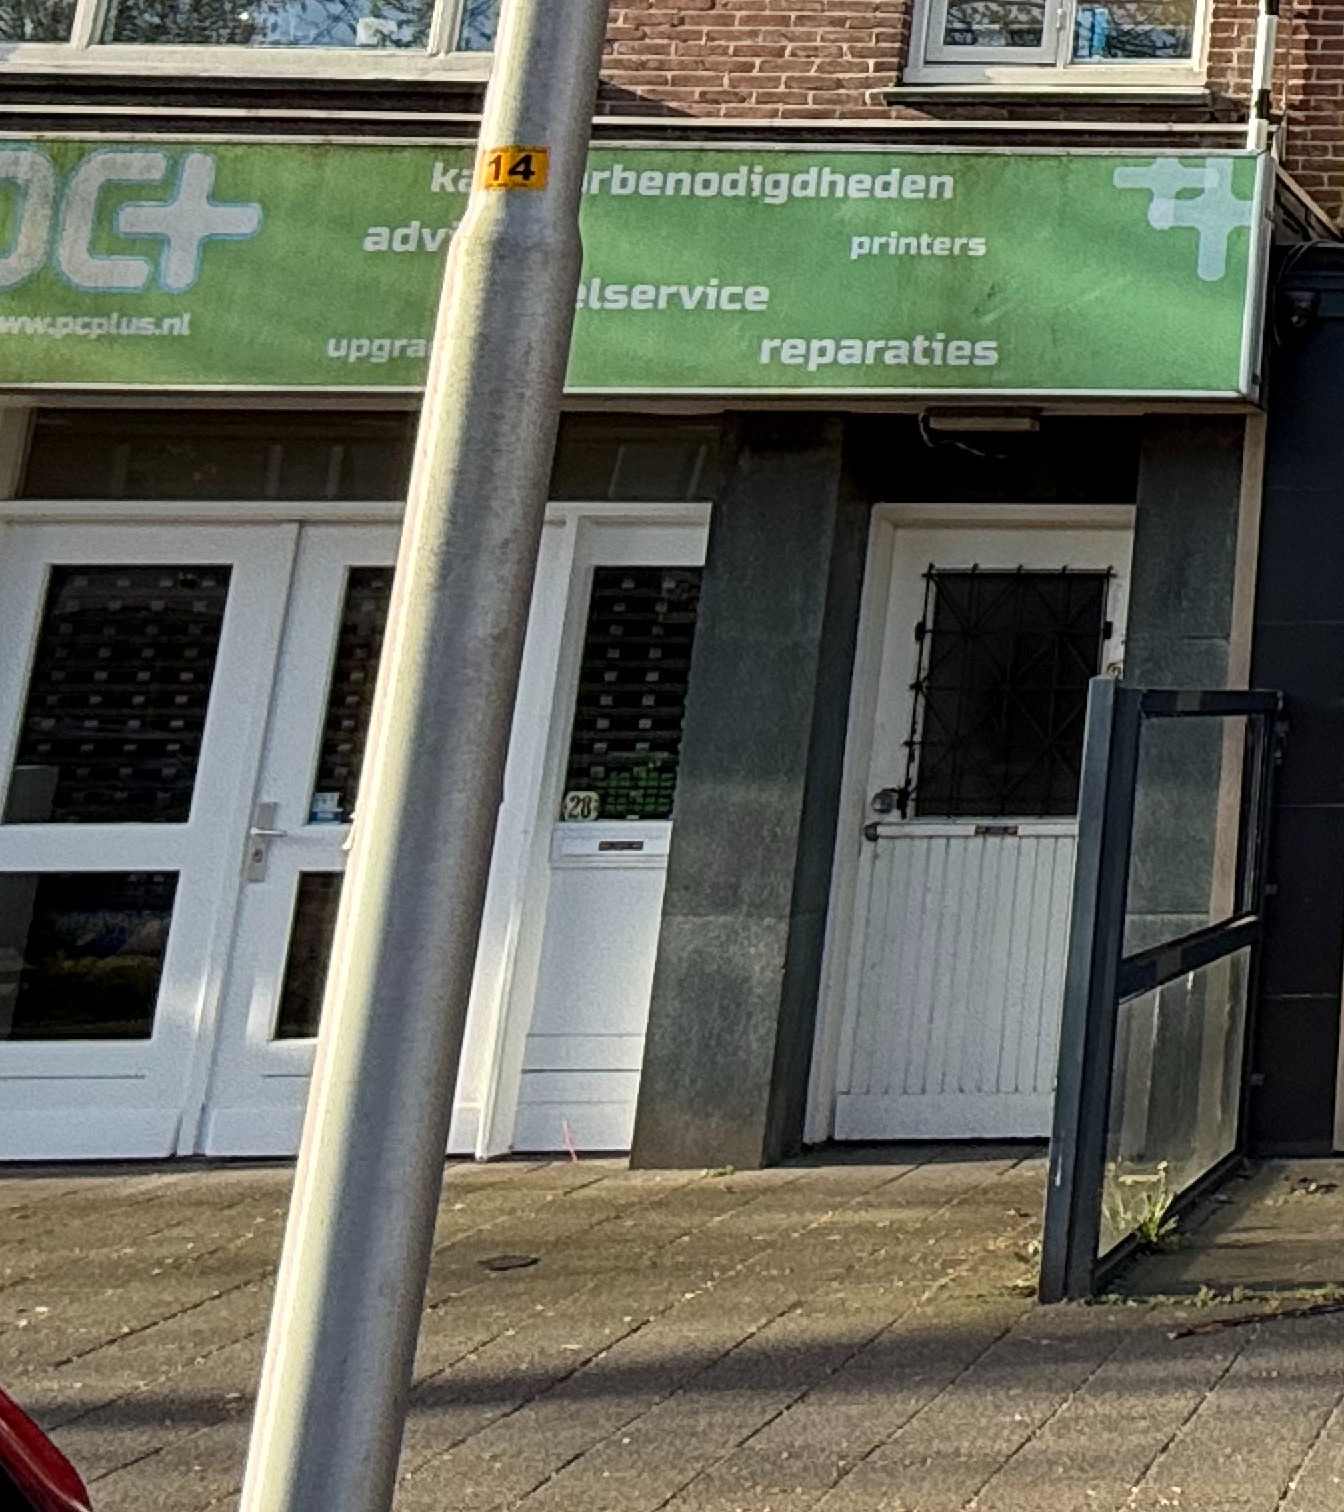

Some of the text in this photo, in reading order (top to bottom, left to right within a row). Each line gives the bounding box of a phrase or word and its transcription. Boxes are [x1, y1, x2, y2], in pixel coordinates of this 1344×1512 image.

[488, 154, 536, 181] 14
[850, 231, 986, 260] printers
[326, 338, 431, 363] upgra
[760, 333, 998, 371] reparaties
